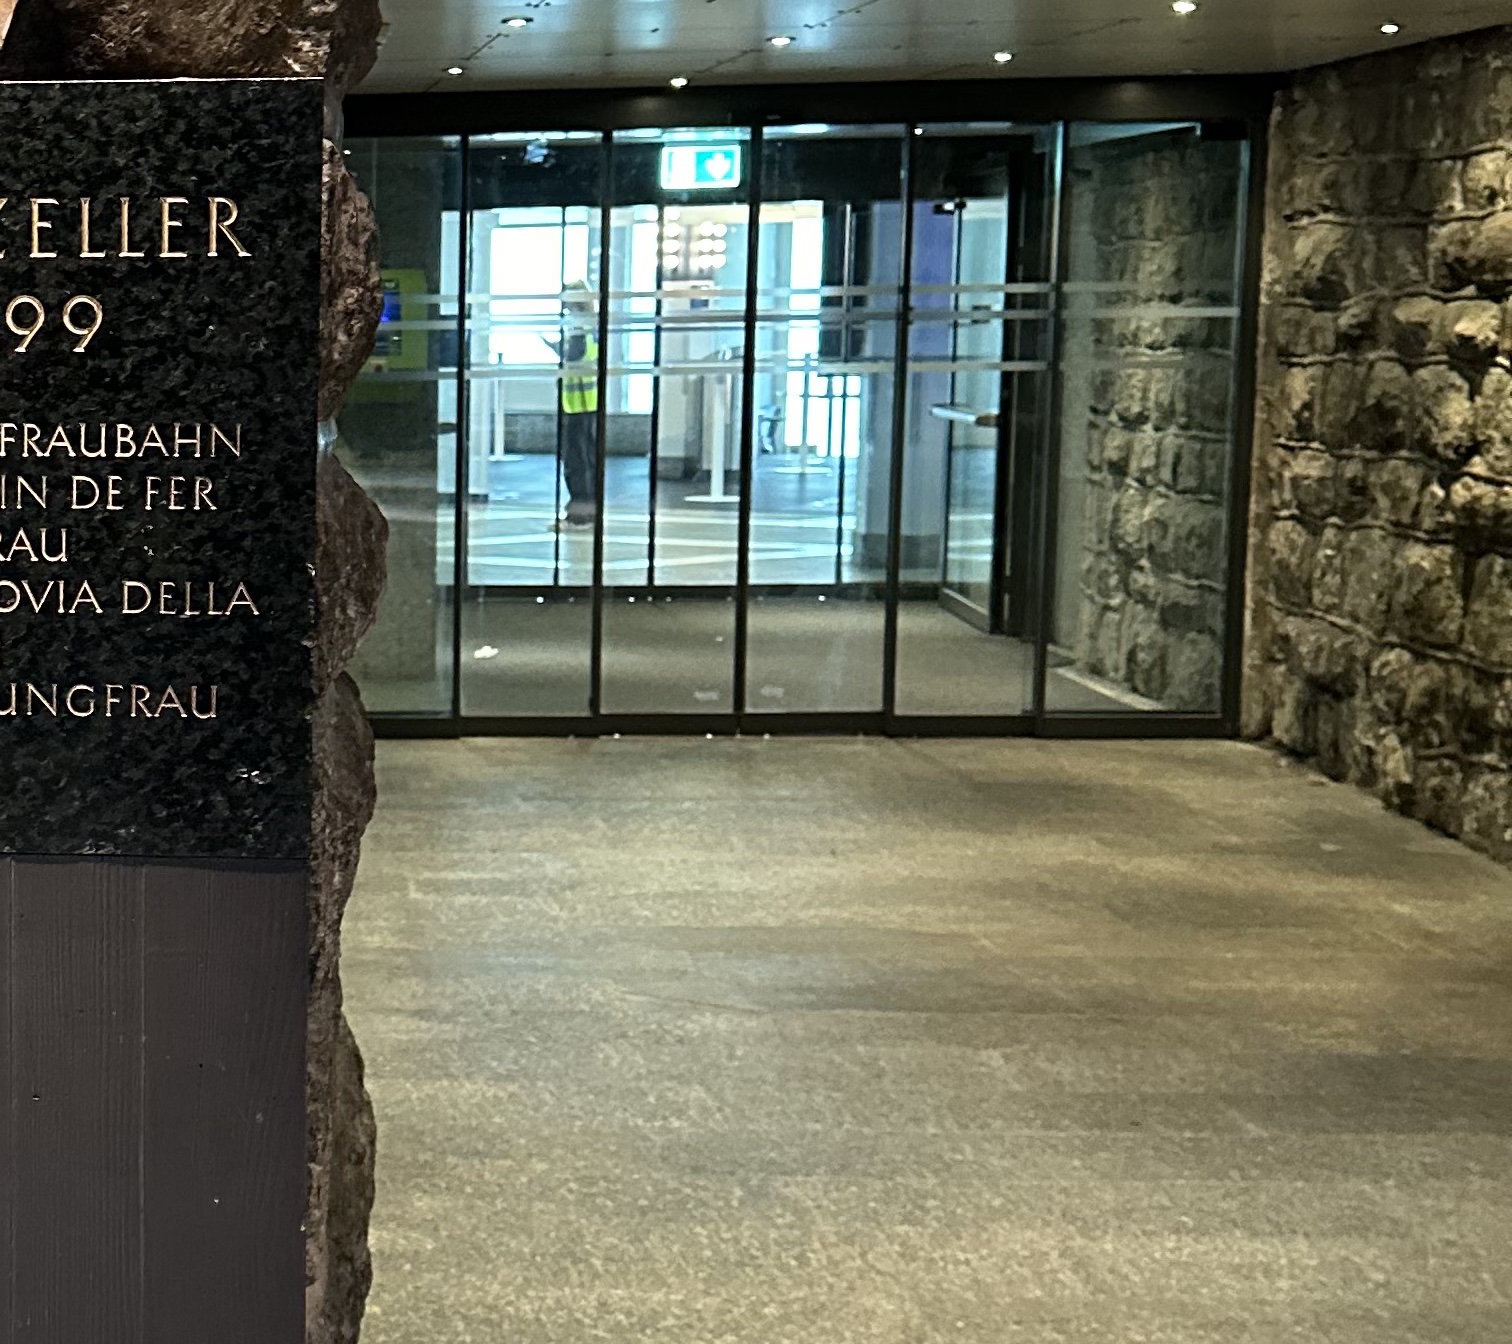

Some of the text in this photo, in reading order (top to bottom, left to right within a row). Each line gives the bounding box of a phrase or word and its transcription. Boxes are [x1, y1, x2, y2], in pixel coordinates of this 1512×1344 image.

[70, 475, 125, 511] DE
[144, 475, 219, 511] FER
[121, 579, 261, 616] DELLA
